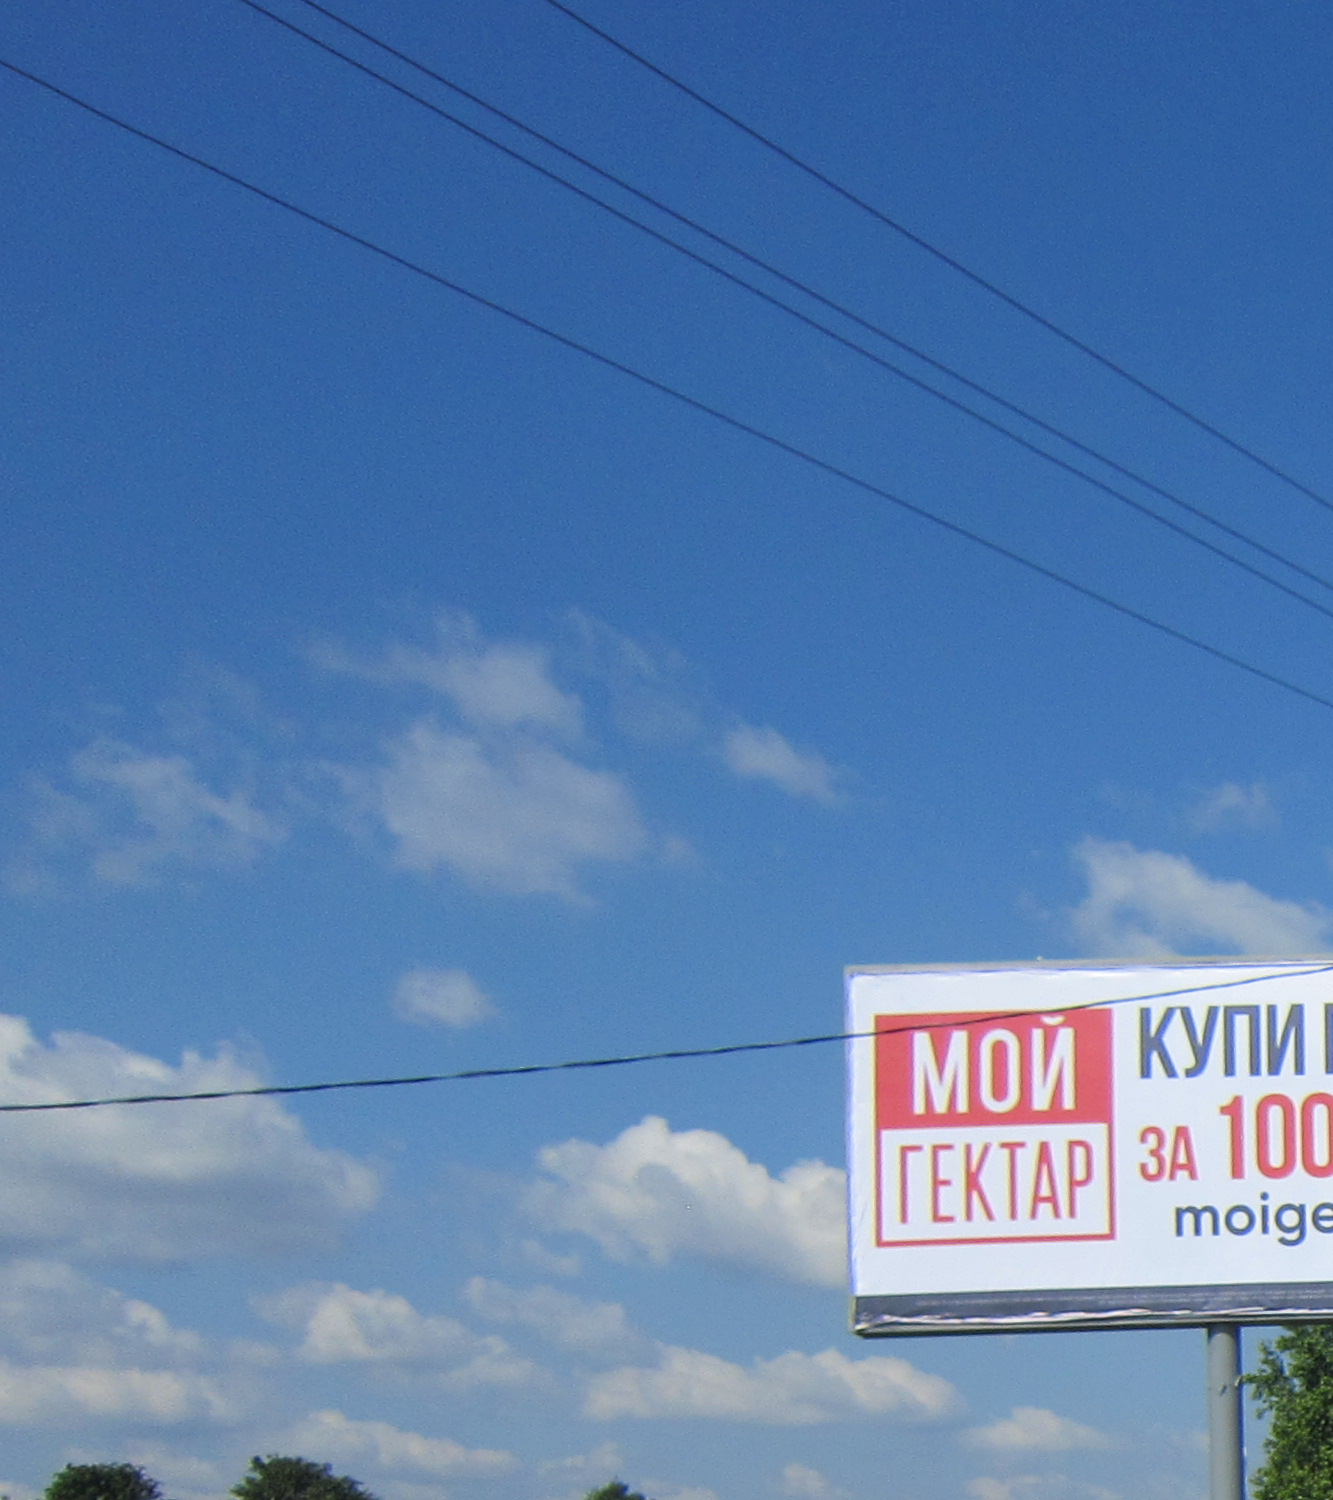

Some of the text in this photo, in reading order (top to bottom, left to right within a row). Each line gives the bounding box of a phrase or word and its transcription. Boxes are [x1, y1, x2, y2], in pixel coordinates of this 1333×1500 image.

[912, 1014, 1077, 1116] МОЙ
[1139, 1003, 1305, 1079] КУПИ
[899, 1140, 1094, 1223] ГЕКТАР
[1140, 1126, 1198, 1182] ЗА
